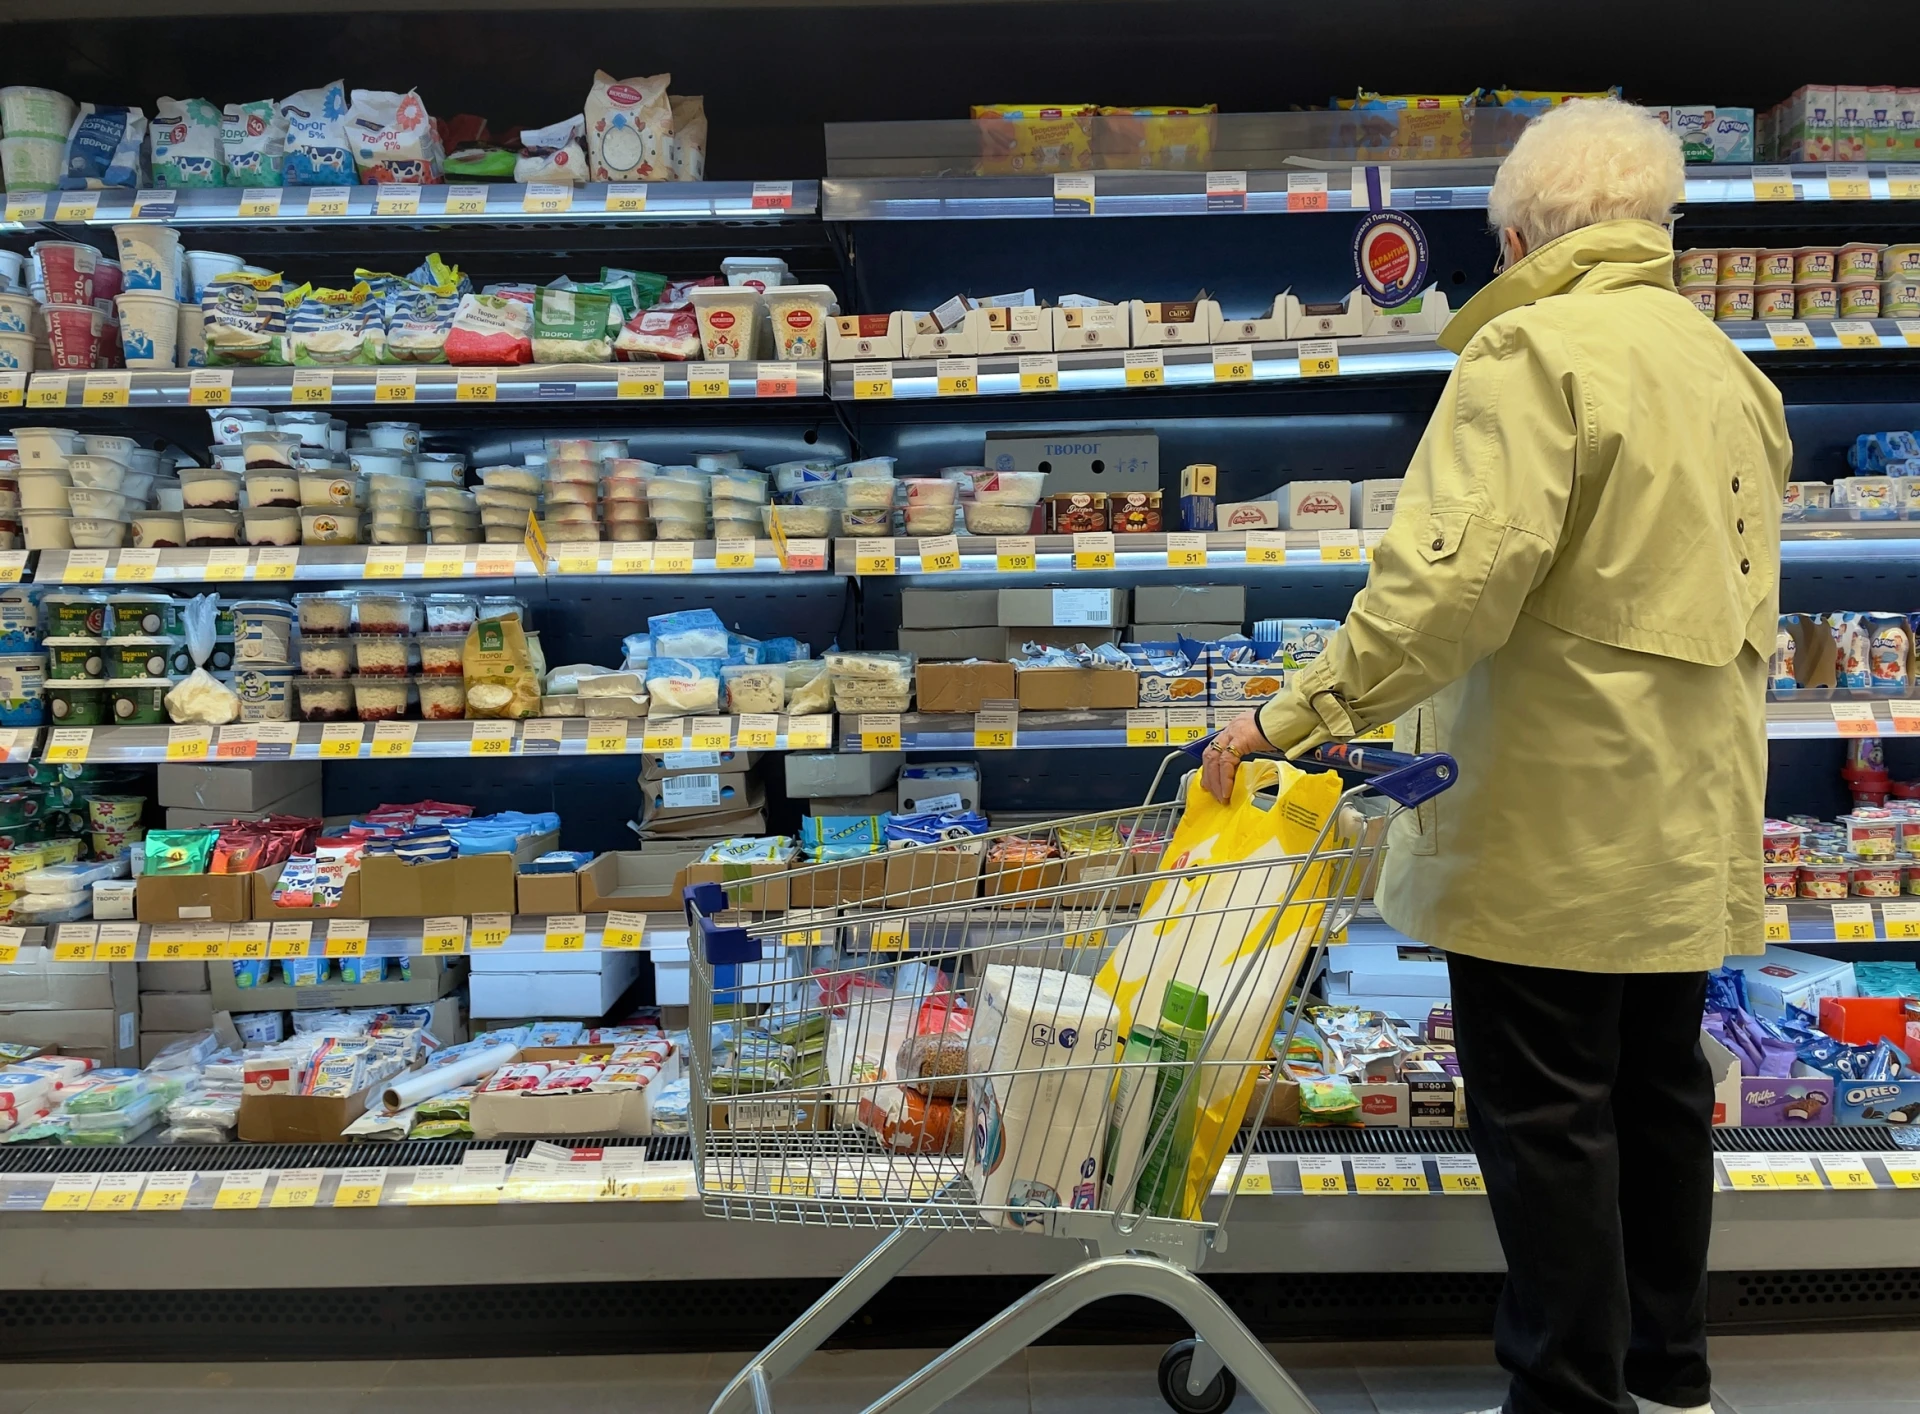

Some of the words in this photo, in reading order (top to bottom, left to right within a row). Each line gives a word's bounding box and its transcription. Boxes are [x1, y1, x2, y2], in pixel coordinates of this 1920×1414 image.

[308, 130, 326, 140] 5%
[80, 138, 114, 151] ТВОРОГ
[384, 142, 400, 150] 9%
[1772, 186, 1784, 194] 43
[1848, 184, 1860, 192] 51
[540, 200, 557, 209] 109
[618, 200, 637, 208] 289
[1300, 196, 1318, 205] 139
[252, 205, 270, 214] 196
[320, 203, 338, 212] 213
[391, 202, 410, 210] 217
[458, 202, 476, 210] 270
[18, 208, 36, 218] 209
[69, 208, 86, 217] 129
[1372, 213, 1402, 222] Покупка
[1370, 244, 1409, 268] ГАРАНТИЯ
[477, 308, 498, 320] Творог
[466, 313, 506, 328] рассыпчатый
[238, 320, 253, 332] 5%
[340, 324, 354, 332] 5%
[540, 330, 574, 338] ТВОРОГ
[52, 312, 66, 366] СМЕТАНА
[1232, 366, 1244, 374] 66
[1318, 361, 1330, 370] 66
[1144, 370, 1156, 378] 66
[956, 380, 968, 388] 66
[1038, 376, 1050, 384] 66
[470, 386, 488, 395] 152
[644, 384, 655, 392] 99
[776, 383, 787, 391] 99
[872, 384, 884, 392] 57
[40, 392, 58, 401] 104
[102, 391, 114, 400] 59
[204, 390, 222, 399] 200
[305, 388, 323, 398] 154
[388, 388, 406, 396] 159
[1044, 444, 1102, 456] ТВОРОГ
[1264, 551, 1276, 560] 56
[1340, 548, 1352, 557] 56
[734, 554, 745, 564] 97
[797, 558, 814, 566] 149
[934, 556, 952, 566] 102
[1008, 557, 1026, 566] 199
[1094, 554, 1106, 563] 49
[1186, 553, 1198, 562] 51
[383, 564, 395, 573] 89
[577, 560, 590, 568] 94
[624, 560, 642, 568] 118
[666, 560, 684, 568] 101
[874, 560, 886, 568] 92
[82, 570, 94, 579] 44
[134, 568, 146, 576] 52
[224, 567, 236, 576] 62
[274, 566, 286, 575] 79
[748, 733, 767, 743] 151
[992, 733, 1004, 742] 15
[1145, 730, 1157, 740] 50
[1187, 730, 1199, 738] 50
[600, 738, 618, 748] 127
[656, 738, 674, 748] 158
[704, 736, 721, 746] 138
[874, 735, 892, 745] 108
[180, 744, 198, 754] 119
[338, 742, 351, 752] 95
[389, 742, 402, 752] 86
[483, 740, 501, 750] 259
[66, 748, 78, 758] 69
[230, 745, 247, 755] 109
[1769, 926, 1780, 935] 51
[1854, 926, 1865, 934] 51
[1904, 924, 1916, 933] 51
[484, 932, 501, 942] 111
[563, 936, 575, 946] 87
[620, 934, 633, 944] 89
[888, 936, 901, 944] 65
[288, 942, 300, 952] 78
[346, 941, 358, 950] 78
[441, 938, 454, 948] 94
[74, 946, 86, 955] 83
[110, 946, 127, 955] 136
[166, 944, 179, 954] 86
[206, 944, 218, 953] 90
[246, 944, 258, 952] 64
[1745, 1089, 1776, 1104] Milka
[1850, 1086, 1901, 1103] OREO
[1246, 1178, 1260, 1187] 92
[1322, 1177, 1336, 1187] 89
[1376, 1177, 1390, 1187] 62
[1403, 1177, 1417, 1187] 70
[1457, 1176, 1478, 1186] 164
[1751, 1174, 1766, 1184] 58
[1796, 1174, 1810, 1182] 54
[1848, 1174, 1862, 1182] 67
[112, 1194, 126, 1203] 42
[162, 1194, 176, 1202] 34
[238, 1192, 252, 1200] 42
[288, 1190, 308, 1200] 109
[356, 1190, 370, 1199] 85
